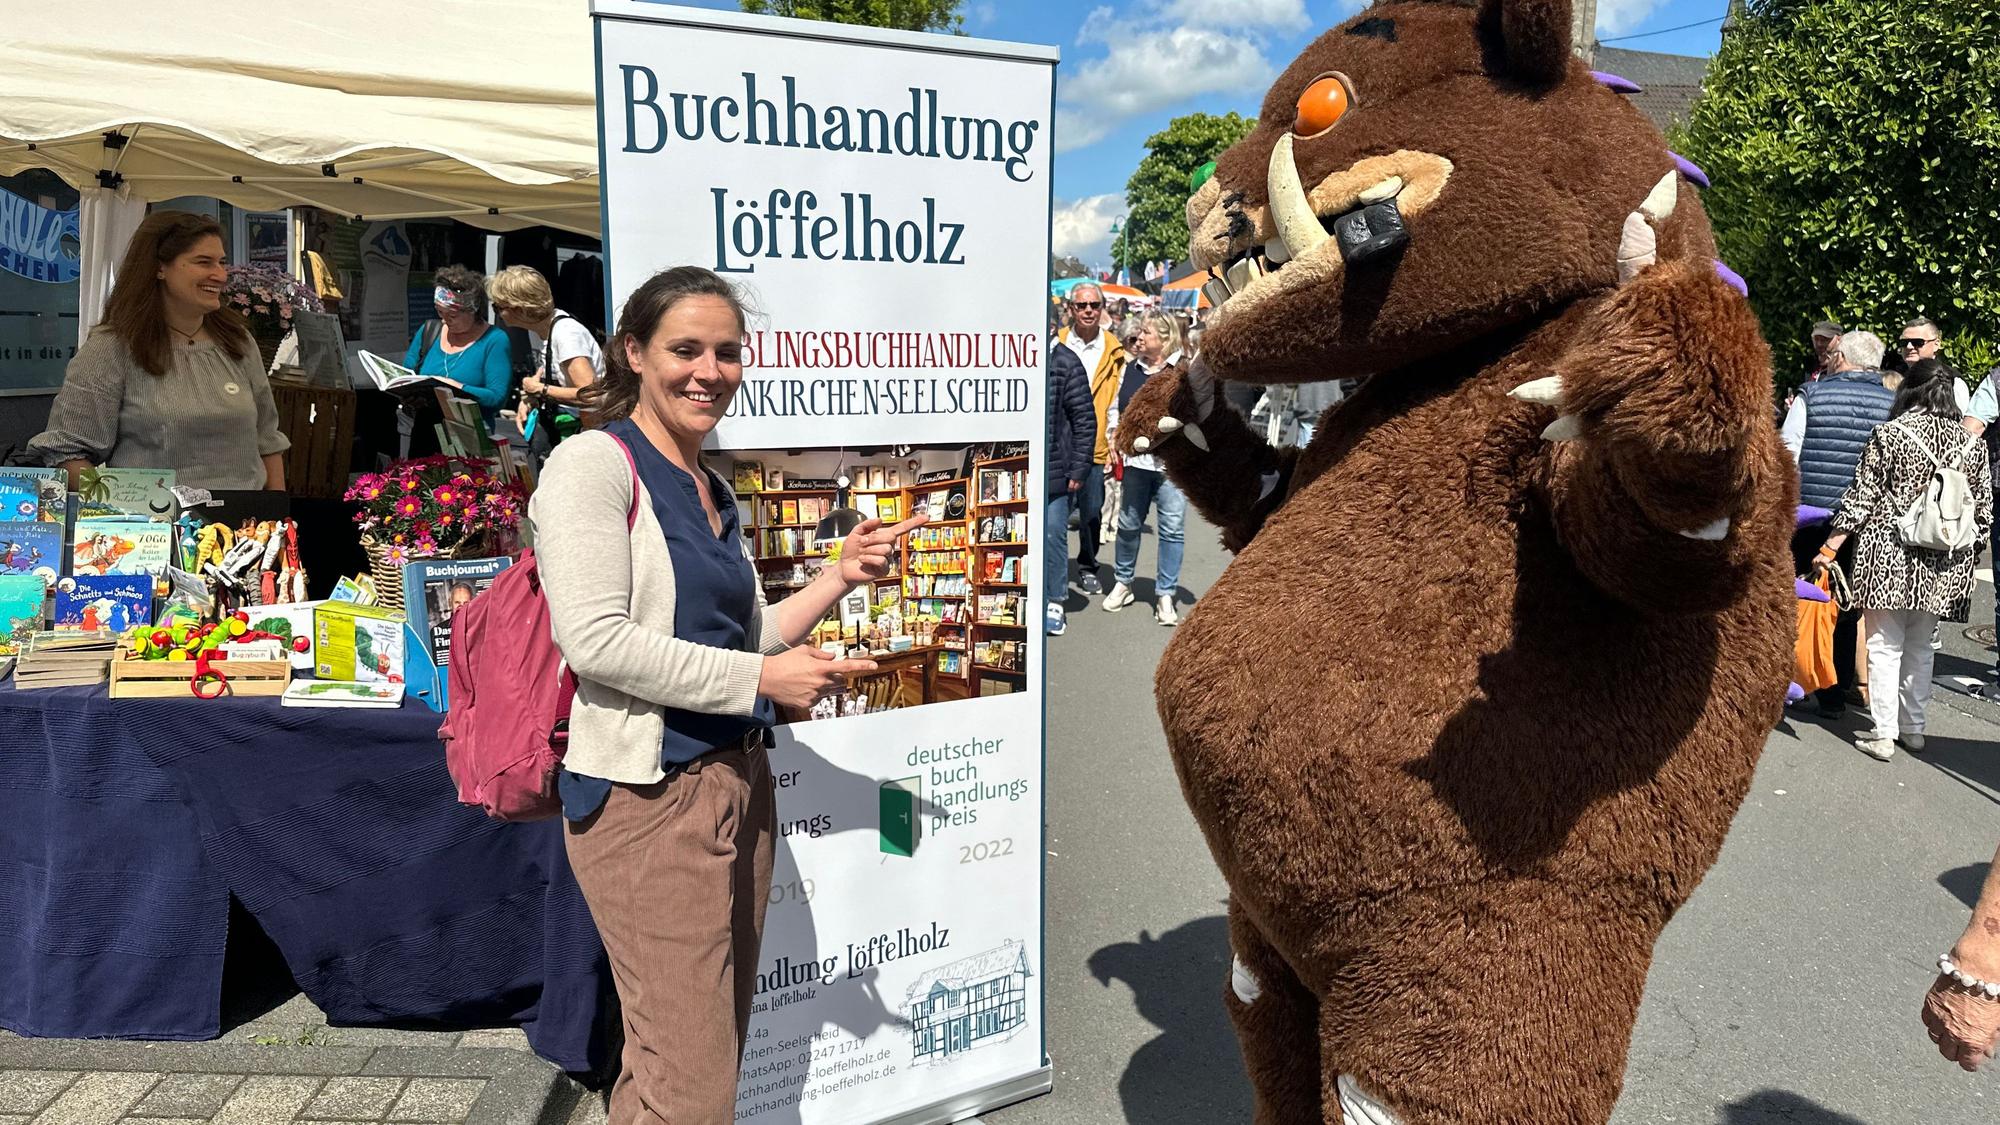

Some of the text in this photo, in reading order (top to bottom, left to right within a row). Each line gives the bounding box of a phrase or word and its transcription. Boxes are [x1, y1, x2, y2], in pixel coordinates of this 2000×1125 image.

[618, 63, 1039, 182] Buchhandlung
[710, 187, 965, 273] Löffelholz
[18, 346, 32, 359] in
[40, 346, 62, 359] die
[139, 534, 167, 543] ZOGG
[426, 563, 493, 577] Buchjournal
[78, 584, 91, 593] Die
[125, 584, 135, 592] die
[907, 737, 1004, 766] deutscher
[931, 761, 977, 786] buch
[931, 778, 1028, 809] handlungs
[781, 814, 831, 838] ungs
[931, 805, 977, 837] preis
[959, 837, 1014, 864] 2022
[754, 921, 950, 995] ndlung Löffelholz
[744, 1026, 840, 1062] chen-Seelscheid
[754, 1028, 769, 1039] 4a
[737, 1036, 867, 1082] hatsApp: 02247 1717
